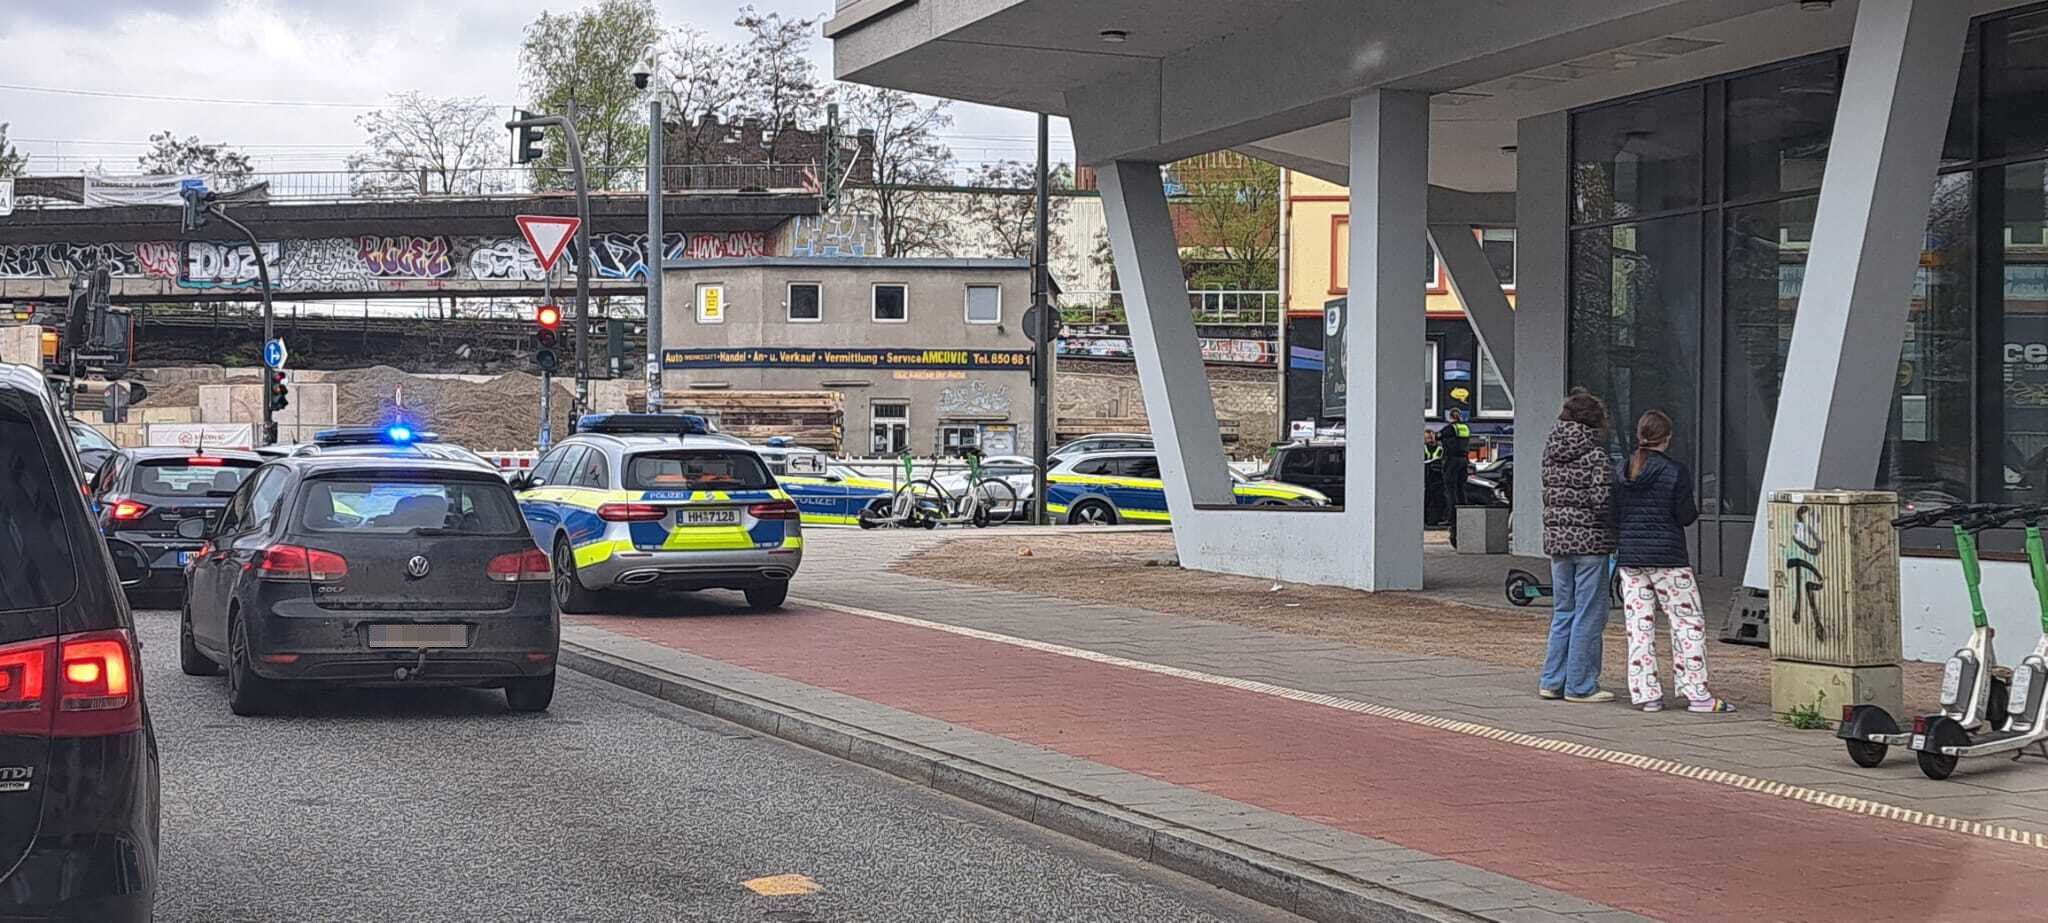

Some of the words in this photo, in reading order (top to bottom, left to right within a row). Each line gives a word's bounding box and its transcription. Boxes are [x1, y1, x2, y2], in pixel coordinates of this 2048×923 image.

[665, 352, 683, 363] Auto
[719, 351, 746, 362] Handel
[779, 351, 816, 363] Verkauf
[824, 352, 878, 365] Vermittlung
[886, 352, 921, 364] Service
[922, 351, 968, 364] AMCOVIC
[650, 491, 684, 500] POLIZEI
[0, 766, 34, 779] TDI
